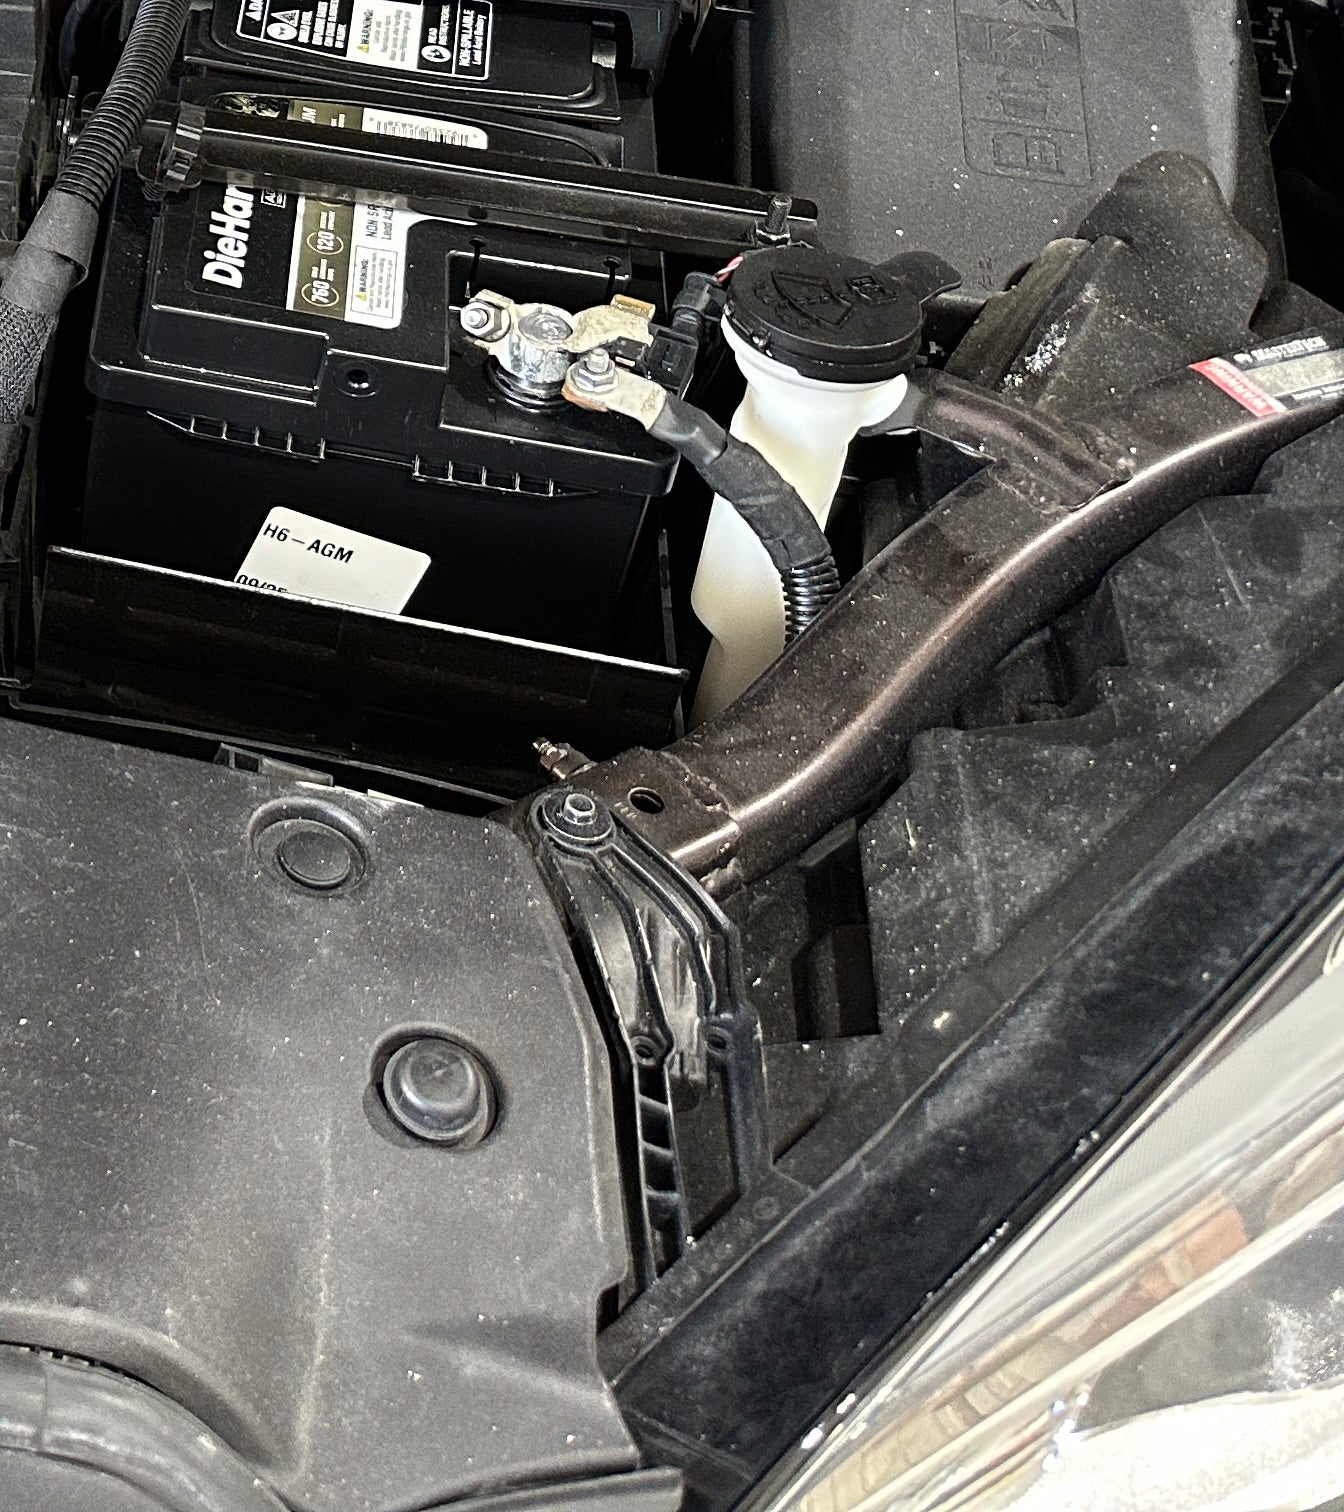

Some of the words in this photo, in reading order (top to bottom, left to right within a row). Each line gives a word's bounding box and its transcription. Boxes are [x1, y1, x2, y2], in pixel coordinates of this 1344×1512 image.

[458, 9, 475, 67] NON-SPILLABLE
[201, 184, 255, 289] DieHar
[316, 230, 336, 251] 120
